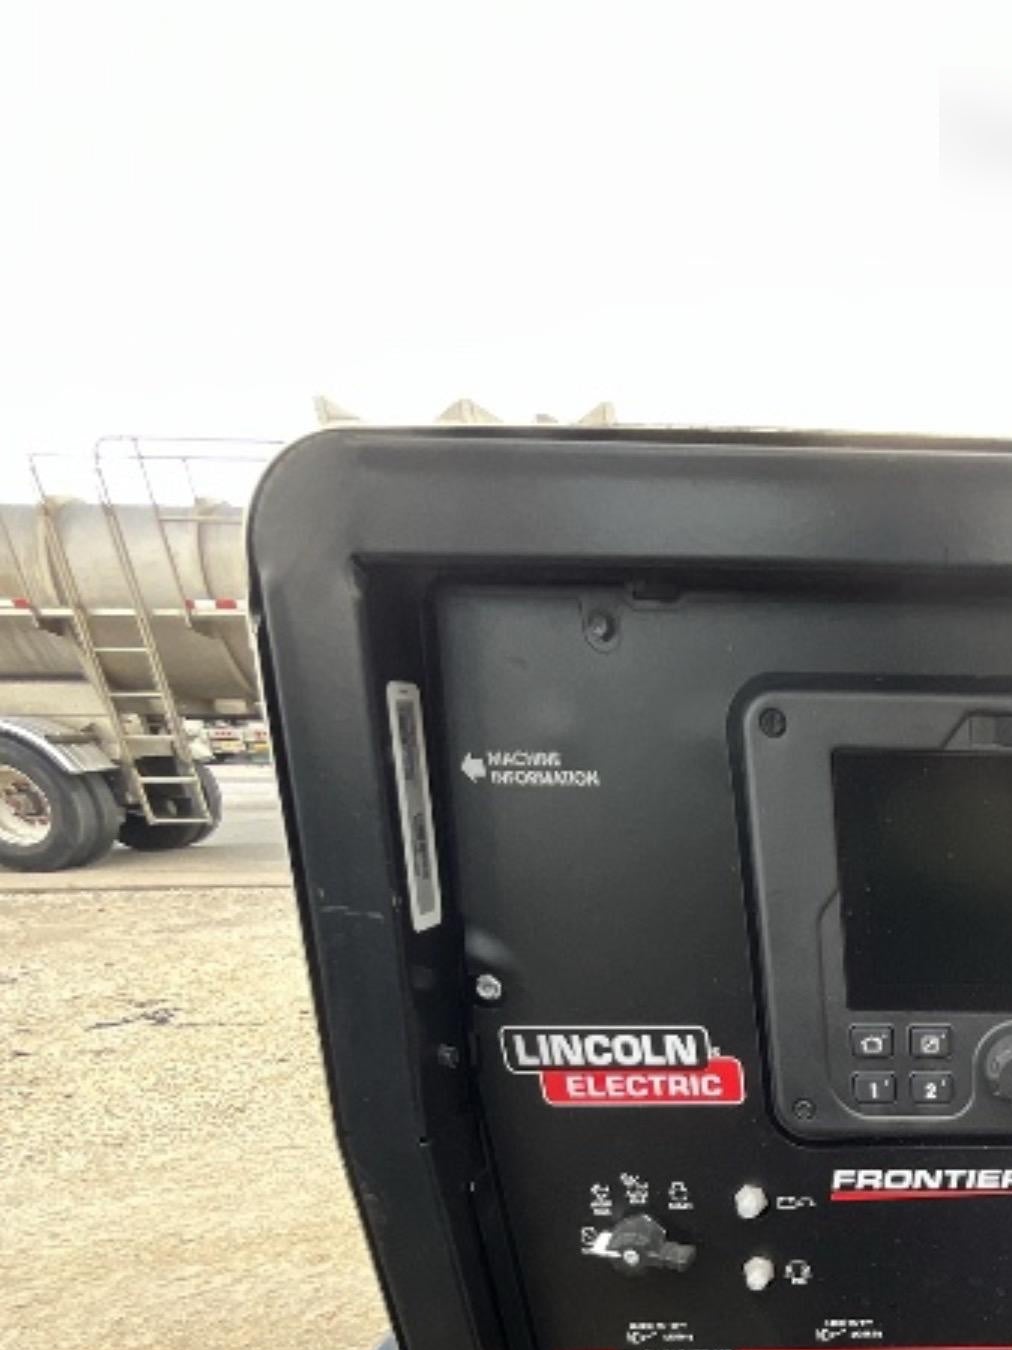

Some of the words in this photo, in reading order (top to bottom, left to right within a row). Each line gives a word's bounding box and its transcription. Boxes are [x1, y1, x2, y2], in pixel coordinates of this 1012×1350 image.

[512, 1034, 698, 1066] LINCOLN
[565, 1075, 723, 1097] ELECTRIC
[925, 1082, 938, 1099] 2
